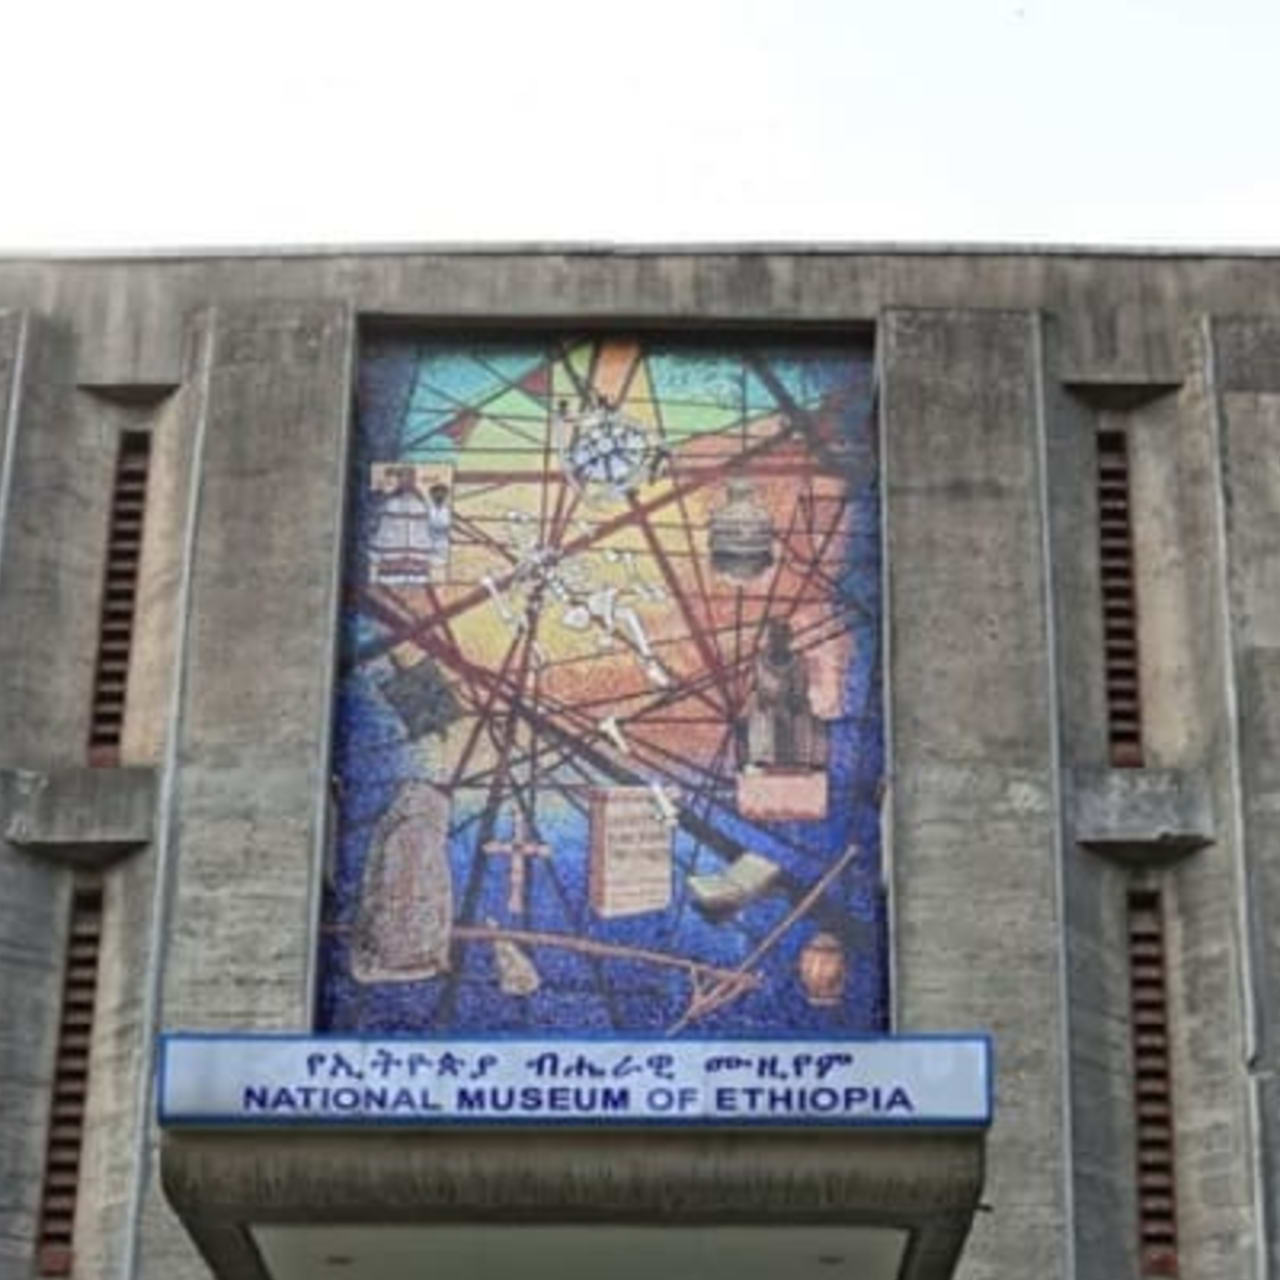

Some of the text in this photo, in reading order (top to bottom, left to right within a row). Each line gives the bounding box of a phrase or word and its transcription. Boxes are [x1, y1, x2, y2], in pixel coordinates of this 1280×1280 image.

[306, 1049, 498, 1080] የኢትዮጵያ
[243, 1087, 915, 1111] NATIONAL MUSEUM OF ETHIOPIA
